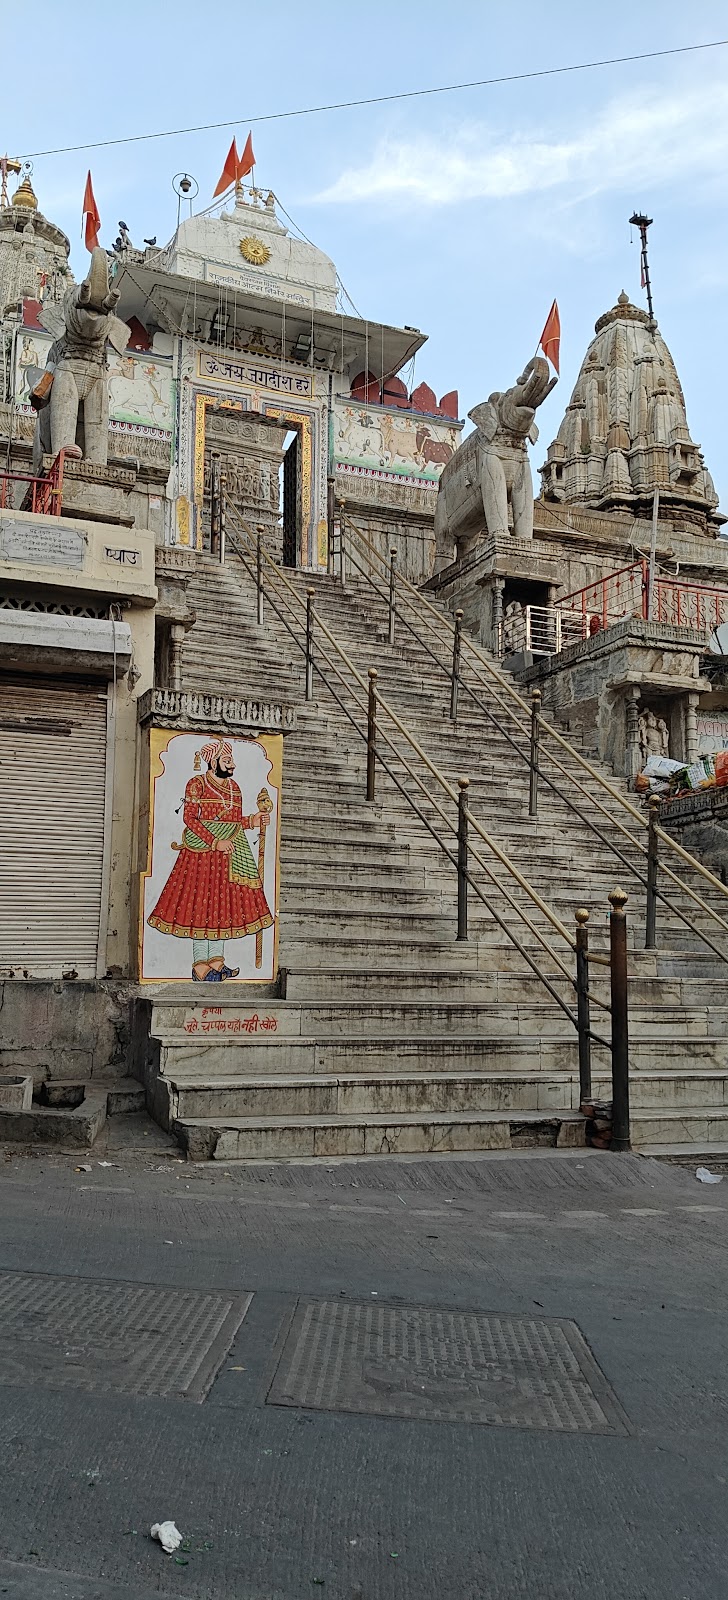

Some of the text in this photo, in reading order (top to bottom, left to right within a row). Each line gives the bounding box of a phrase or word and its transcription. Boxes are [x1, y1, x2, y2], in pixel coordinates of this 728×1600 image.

[209, 272, 241, 286] राजकीय
[247, 368, 293, 391] जगदीश
[295, 377, 310, 395] हरे
